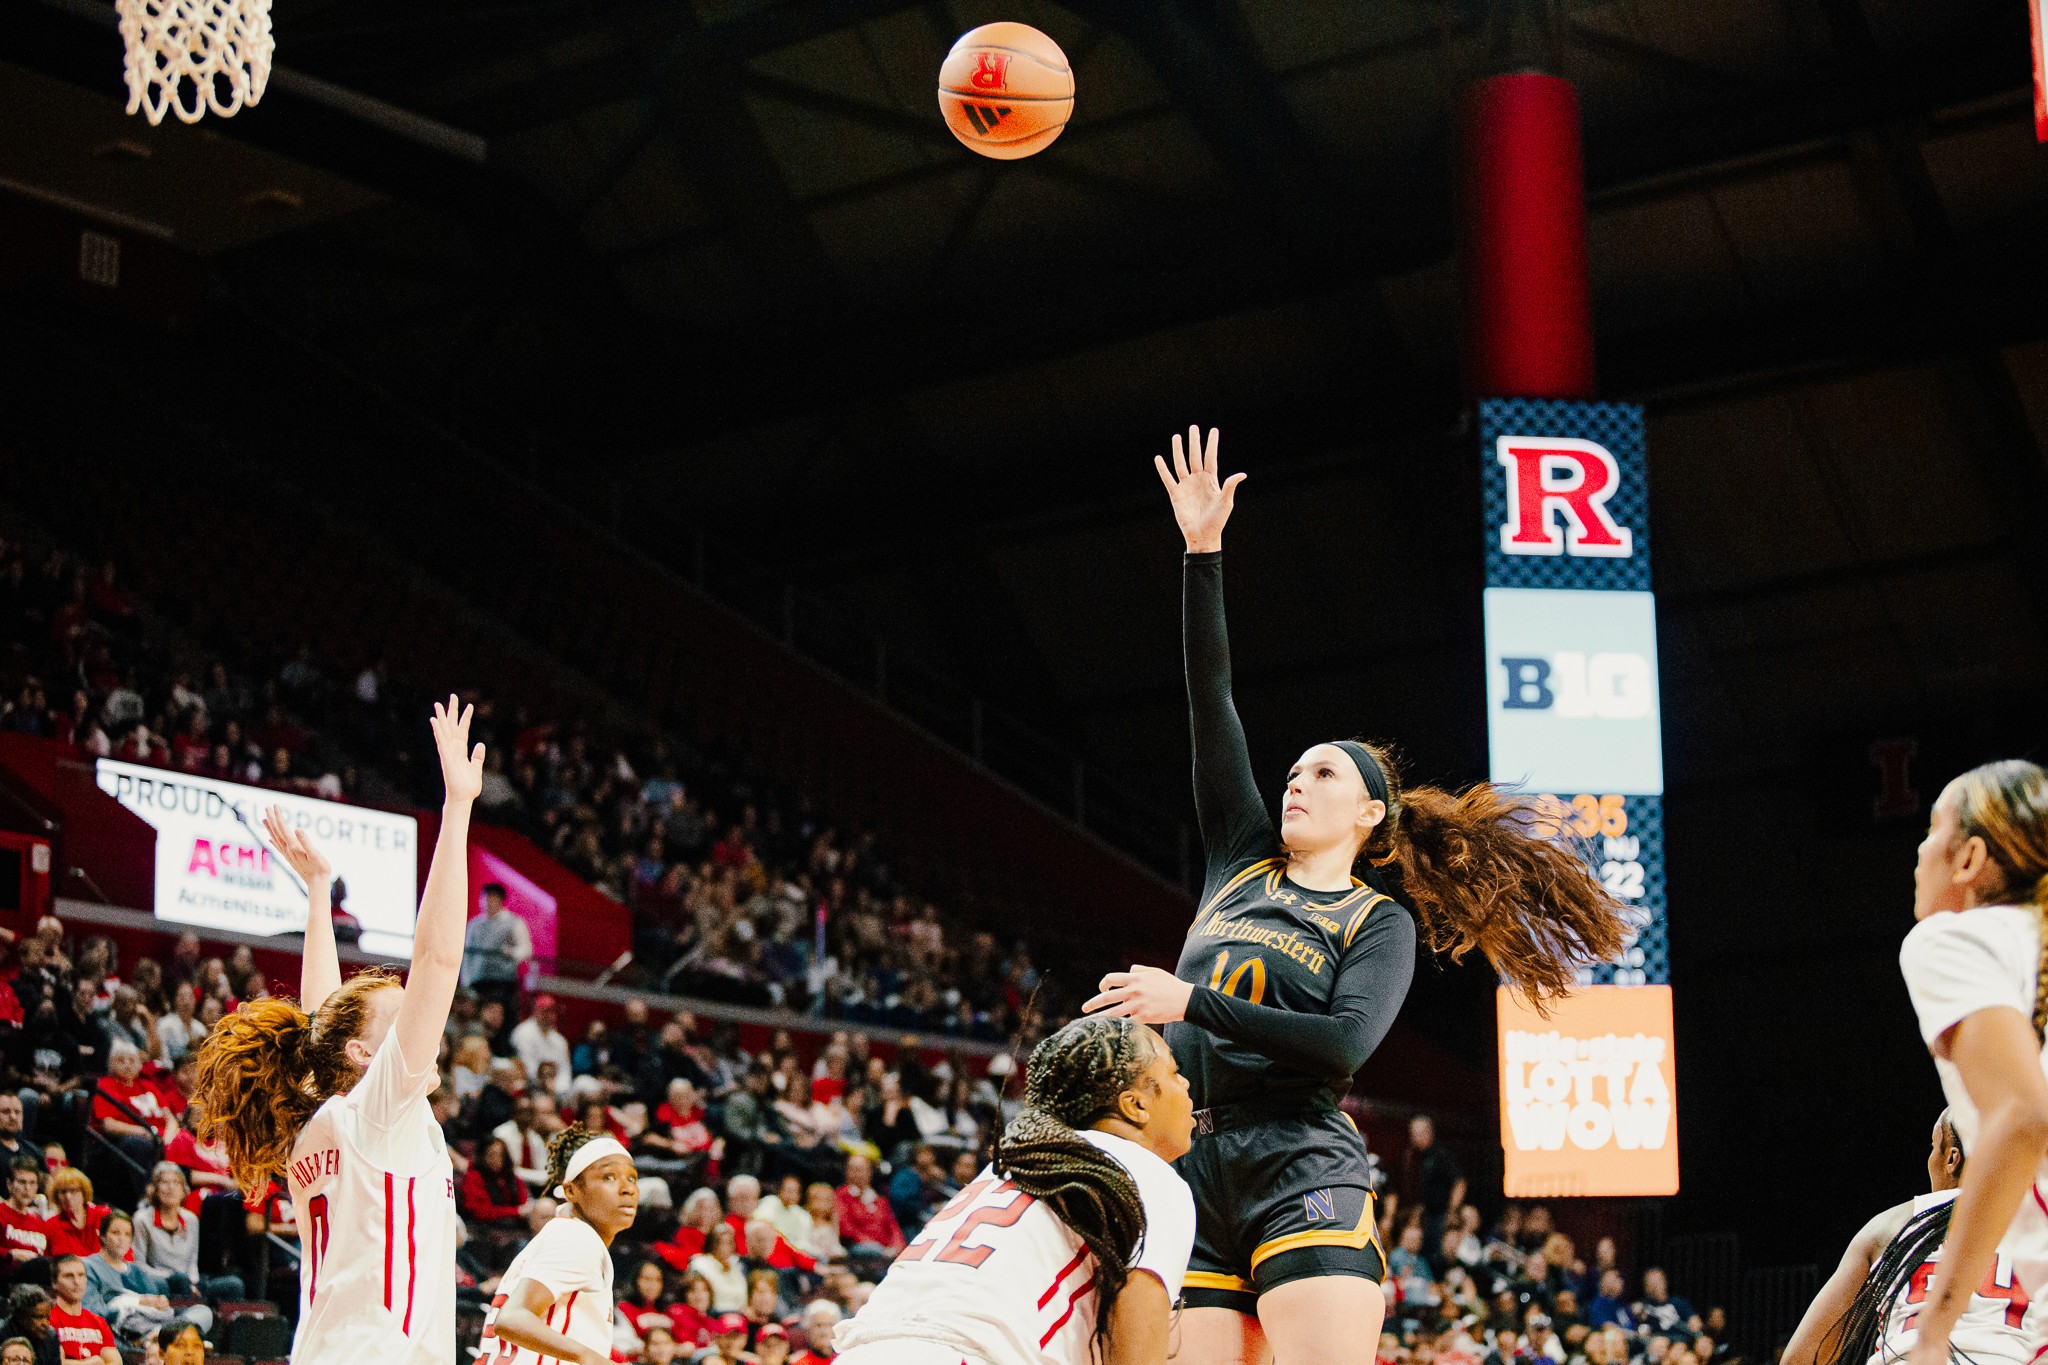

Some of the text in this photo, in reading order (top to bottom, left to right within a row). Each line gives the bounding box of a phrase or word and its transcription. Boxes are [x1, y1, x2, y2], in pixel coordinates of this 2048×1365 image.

[970, 52, 1012, 92] R
[1497, 435, 1633, 558] R
[117, 774, 223, 819] PROUD
[1601, 861, 1645, 899] 22
[1200, 910, 1326, 975] Northwestern
[1209, 949, 1268, 1005] 10
[1505, 1061, 1670, 1105] LOTTA
[1197, 1108, 1214, 1135] N
[1507, 1102, 1671, 1151] WOW
[290, 1148, 340, 1189] HUERER
[1303, 1188, 1336, 1221] N
